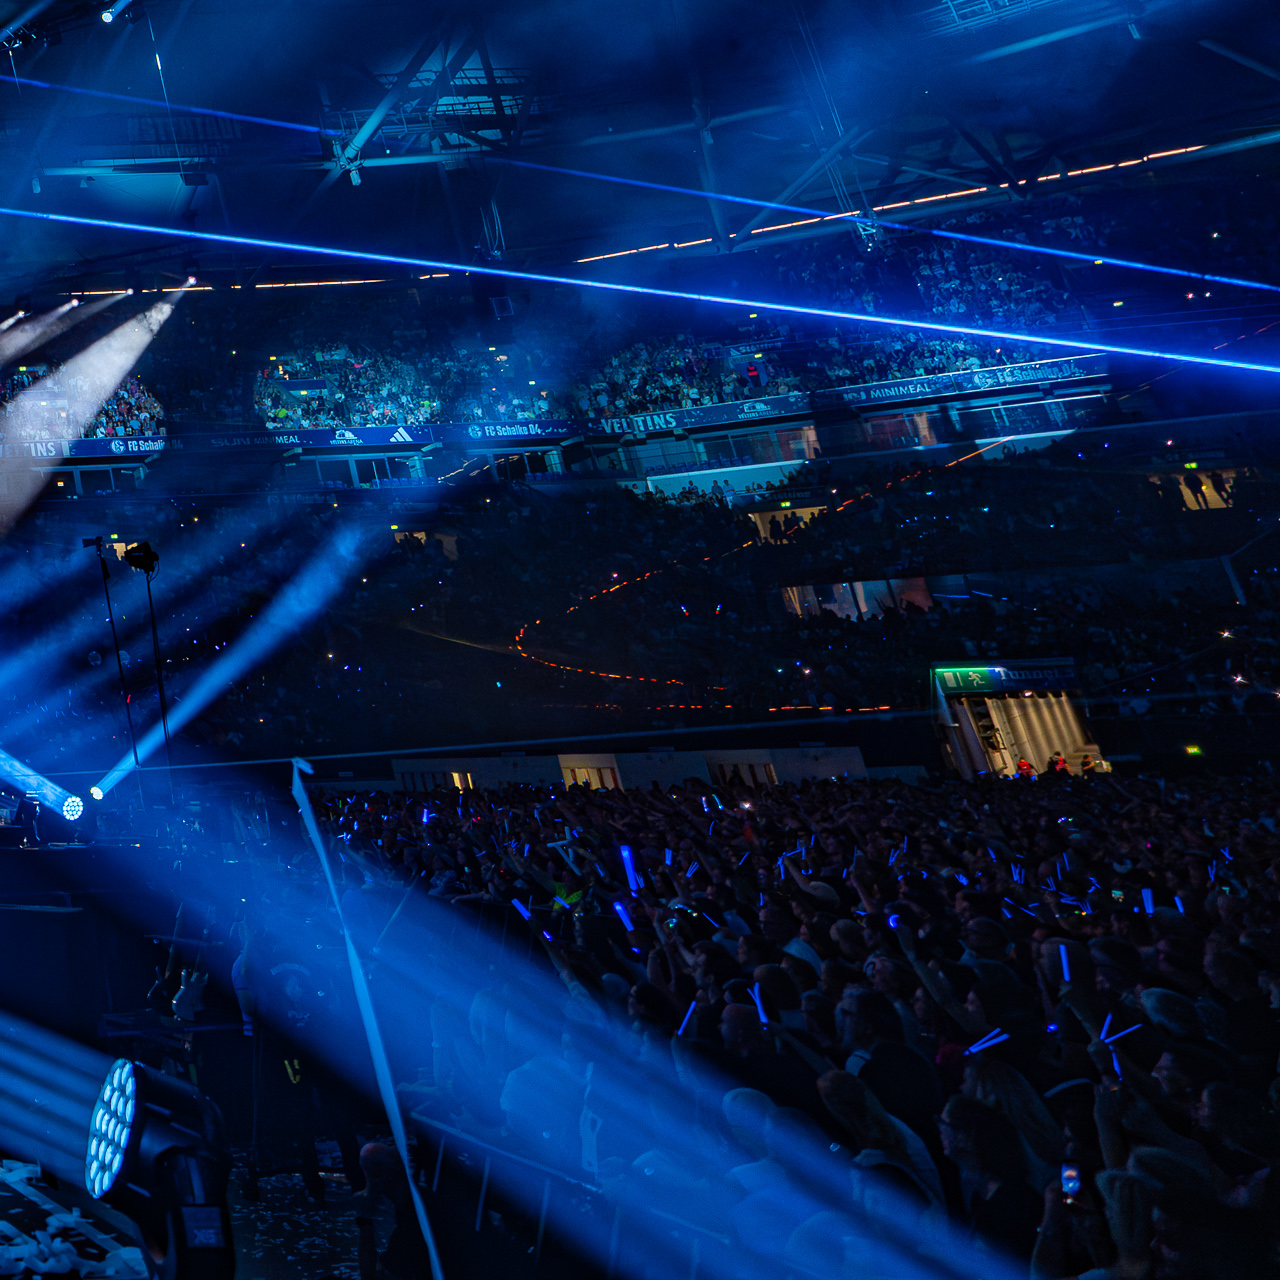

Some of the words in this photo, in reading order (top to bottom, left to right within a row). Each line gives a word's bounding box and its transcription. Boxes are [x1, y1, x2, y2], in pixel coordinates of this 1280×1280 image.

[870, 383, 932, 399] MINIMEAL
[485, 426, 496, 437] FC
[496, 425, 528, 437] Schalke
[529, 423, 541, 435] 04
[601, 413, 677, 434] VELTINS
[127, 440, 139, 452] FC
[254, 435, 301, 445] MINIMEAL
